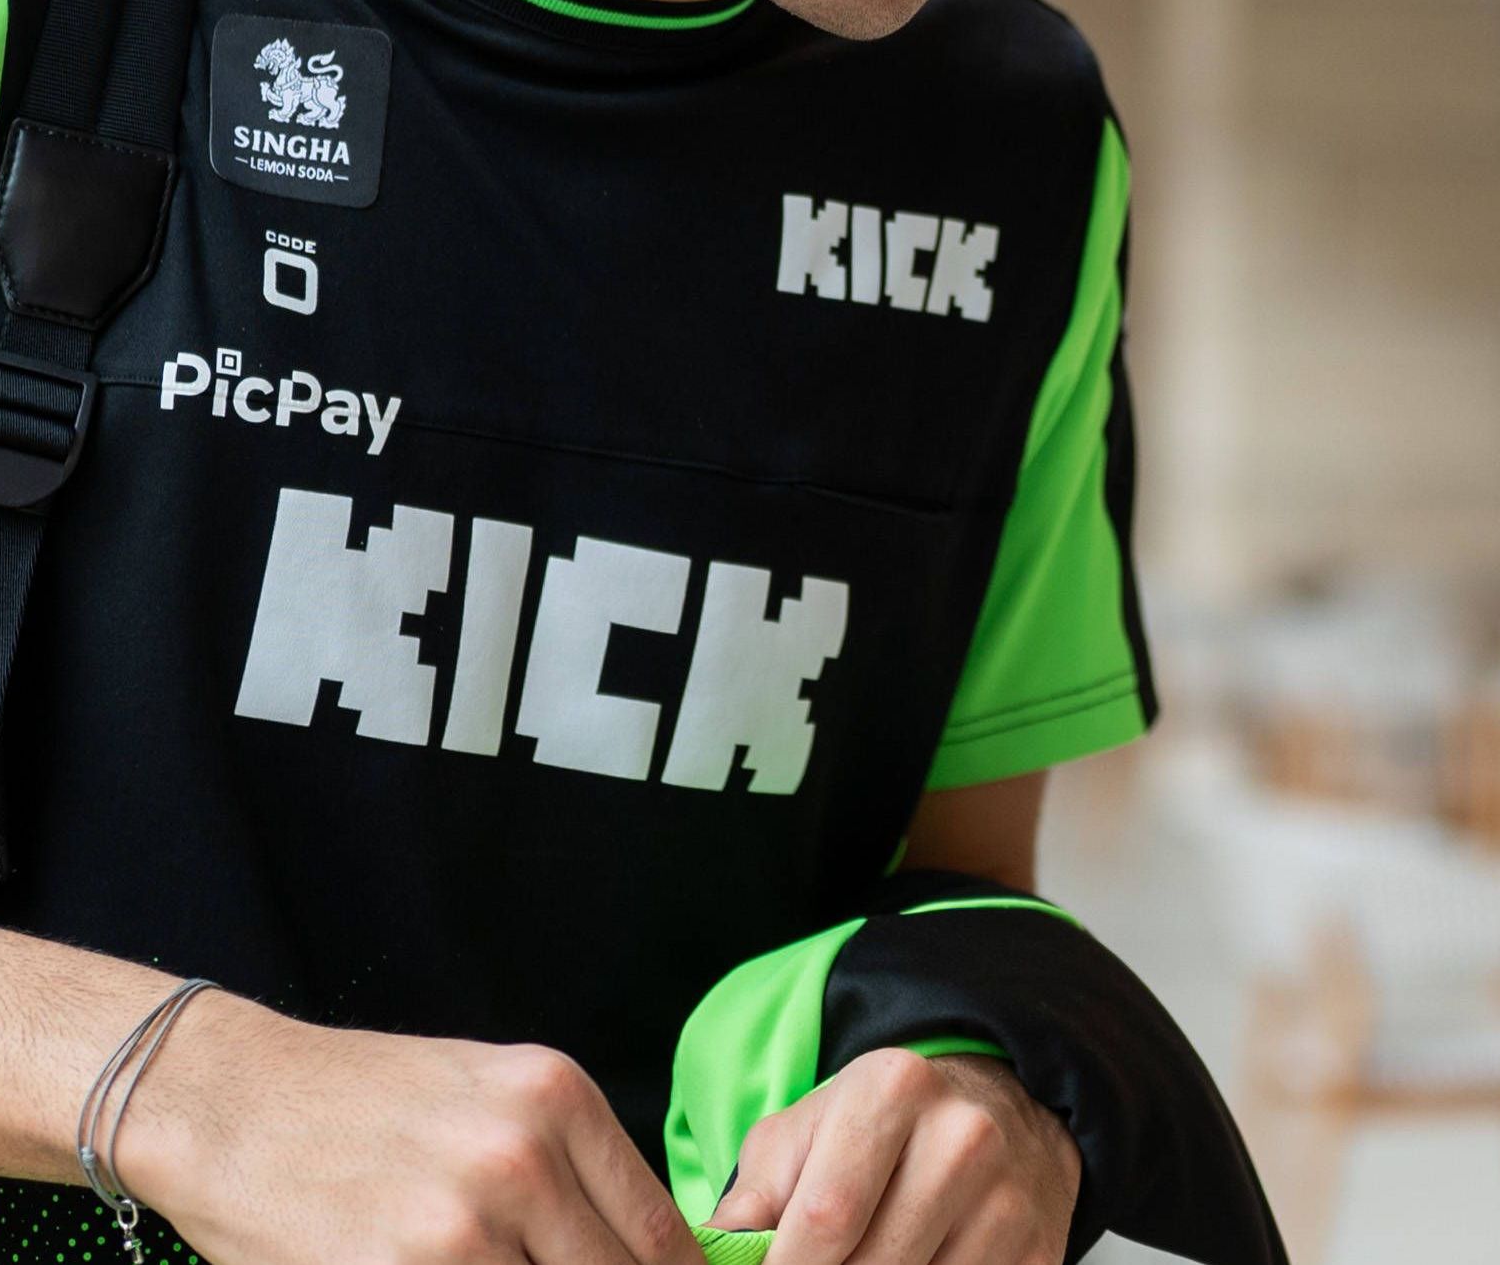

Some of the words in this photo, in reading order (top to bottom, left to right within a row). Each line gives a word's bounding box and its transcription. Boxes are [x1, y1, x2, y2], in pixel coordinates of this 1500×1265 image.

[233, 125, 351, 166] SINGHA
[250, 156, 297, 178] LEMON
[297, 164, 334, 183] SODA
[265, 229, 317, 255] CODE
[777, 193, 999, 322] KICK
[160, 347, 402, 456] PicPay
[235, 488, 849, 796] KICK
